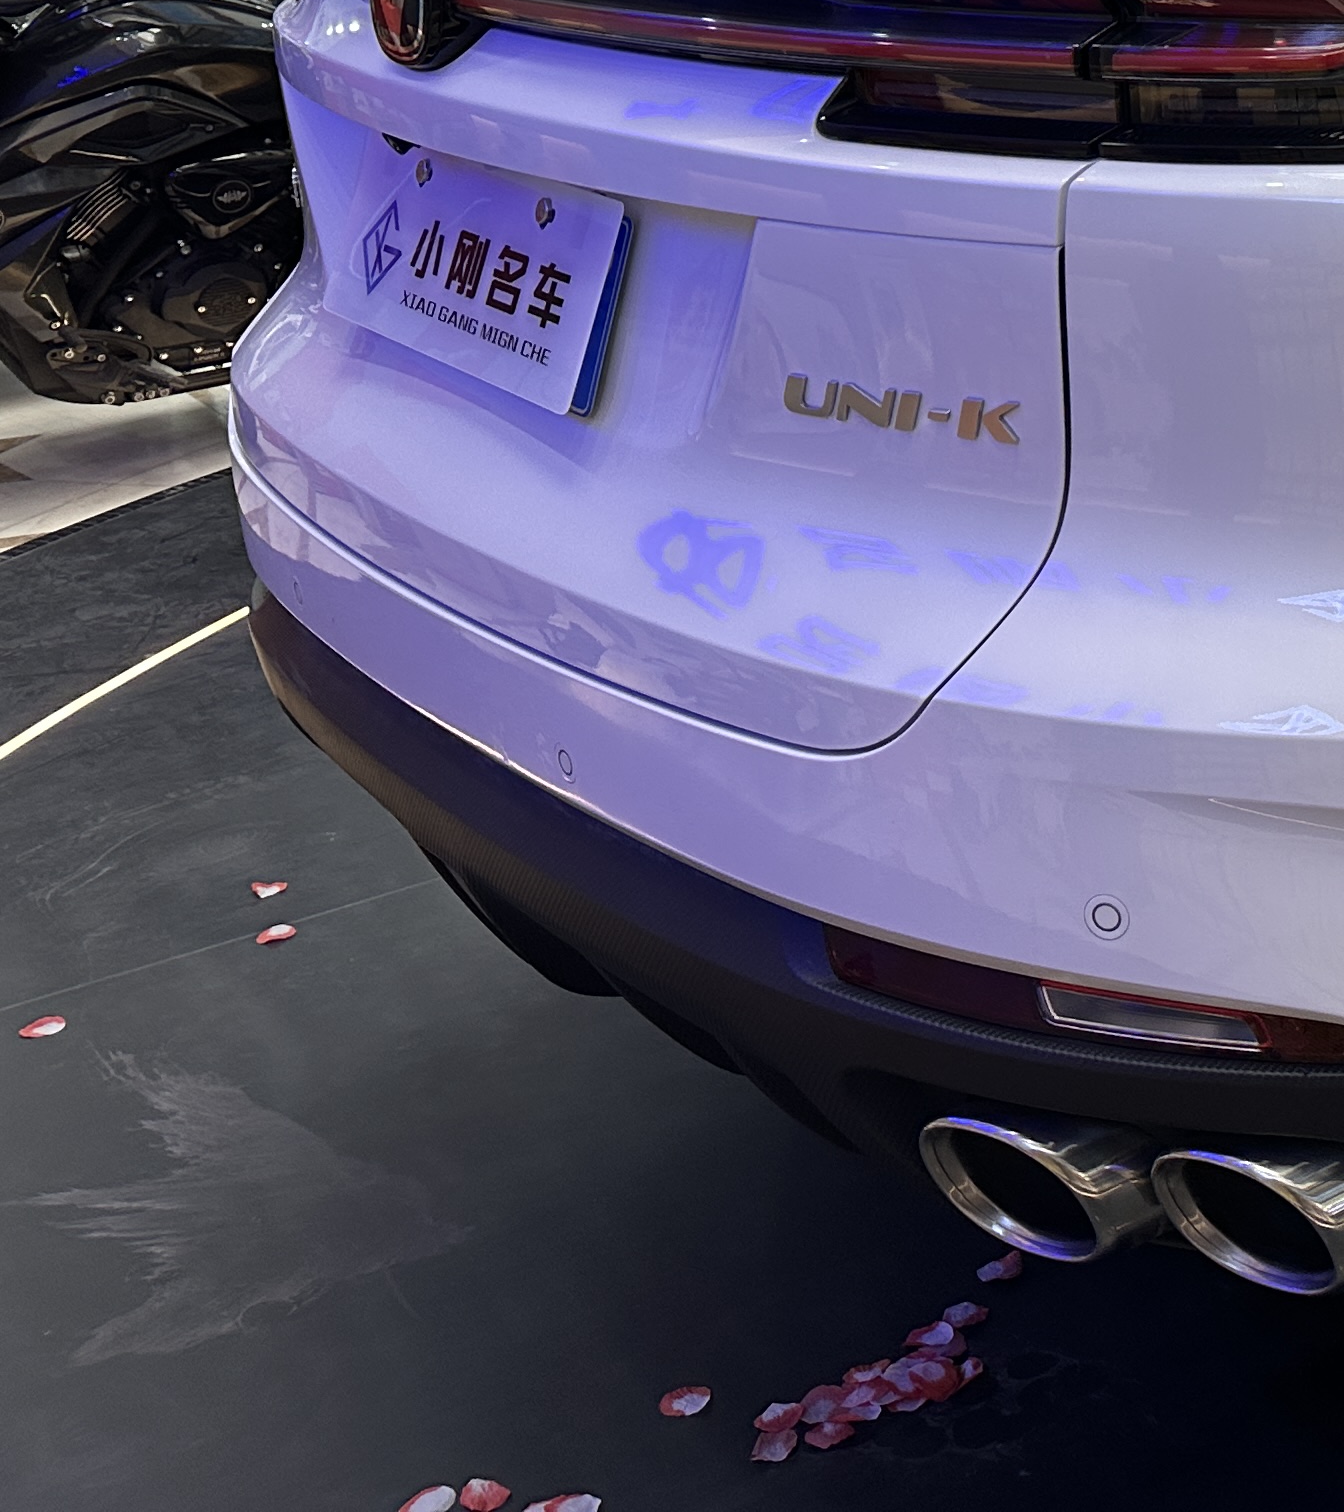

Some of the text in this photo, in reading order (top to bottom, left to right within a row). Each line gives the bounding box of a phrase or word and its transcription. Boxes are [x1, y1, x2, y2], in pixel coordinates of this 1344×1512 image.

[410, 220, 571, 329] 小刚名车
[400, 289, 552, 367] XIAO GANG MIGN CHE
[783, 372, 1021, 445] UNI-K
